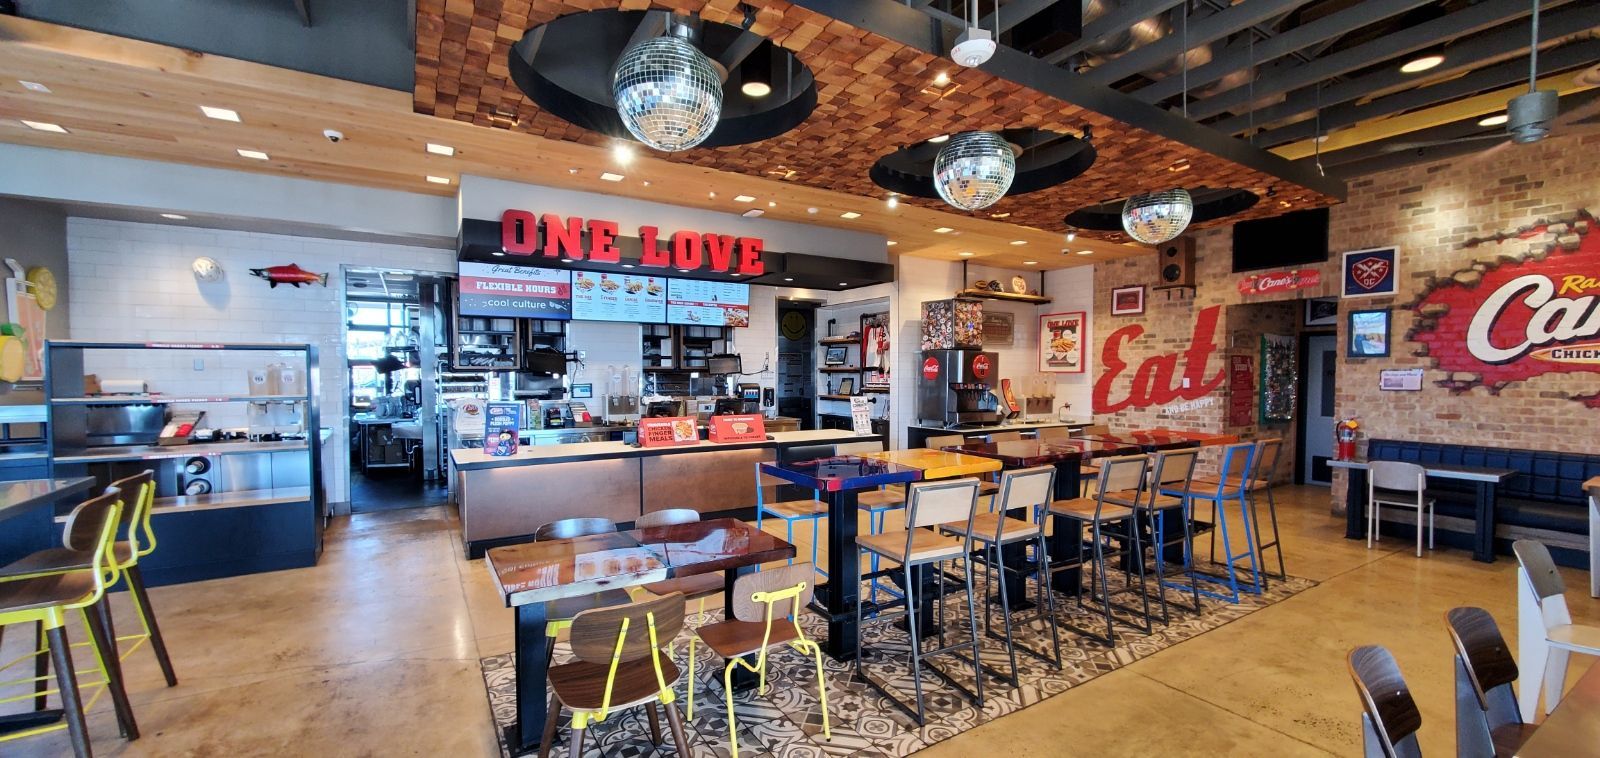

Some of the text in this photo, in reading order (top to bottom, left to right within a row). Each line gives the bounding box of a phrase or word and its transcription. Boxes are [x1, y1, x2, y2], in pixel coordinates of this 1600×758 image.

[502, 209, 765, 275] ONE LOVE
[492, 264, 541, 277] Great Benefits
[476, 281, 556, 294] FLEXIBLE HOURS
[1258, 276, 1291, 291] Cane's
[1558, 274, 1600, 295] Ra
[487, 299, 546, 309] cool culture
[1466, 274, 1600, 366] Ca
[1092, 304, 1227, 415] Eat
[1190, 396, 1214, 410] HAPPY
